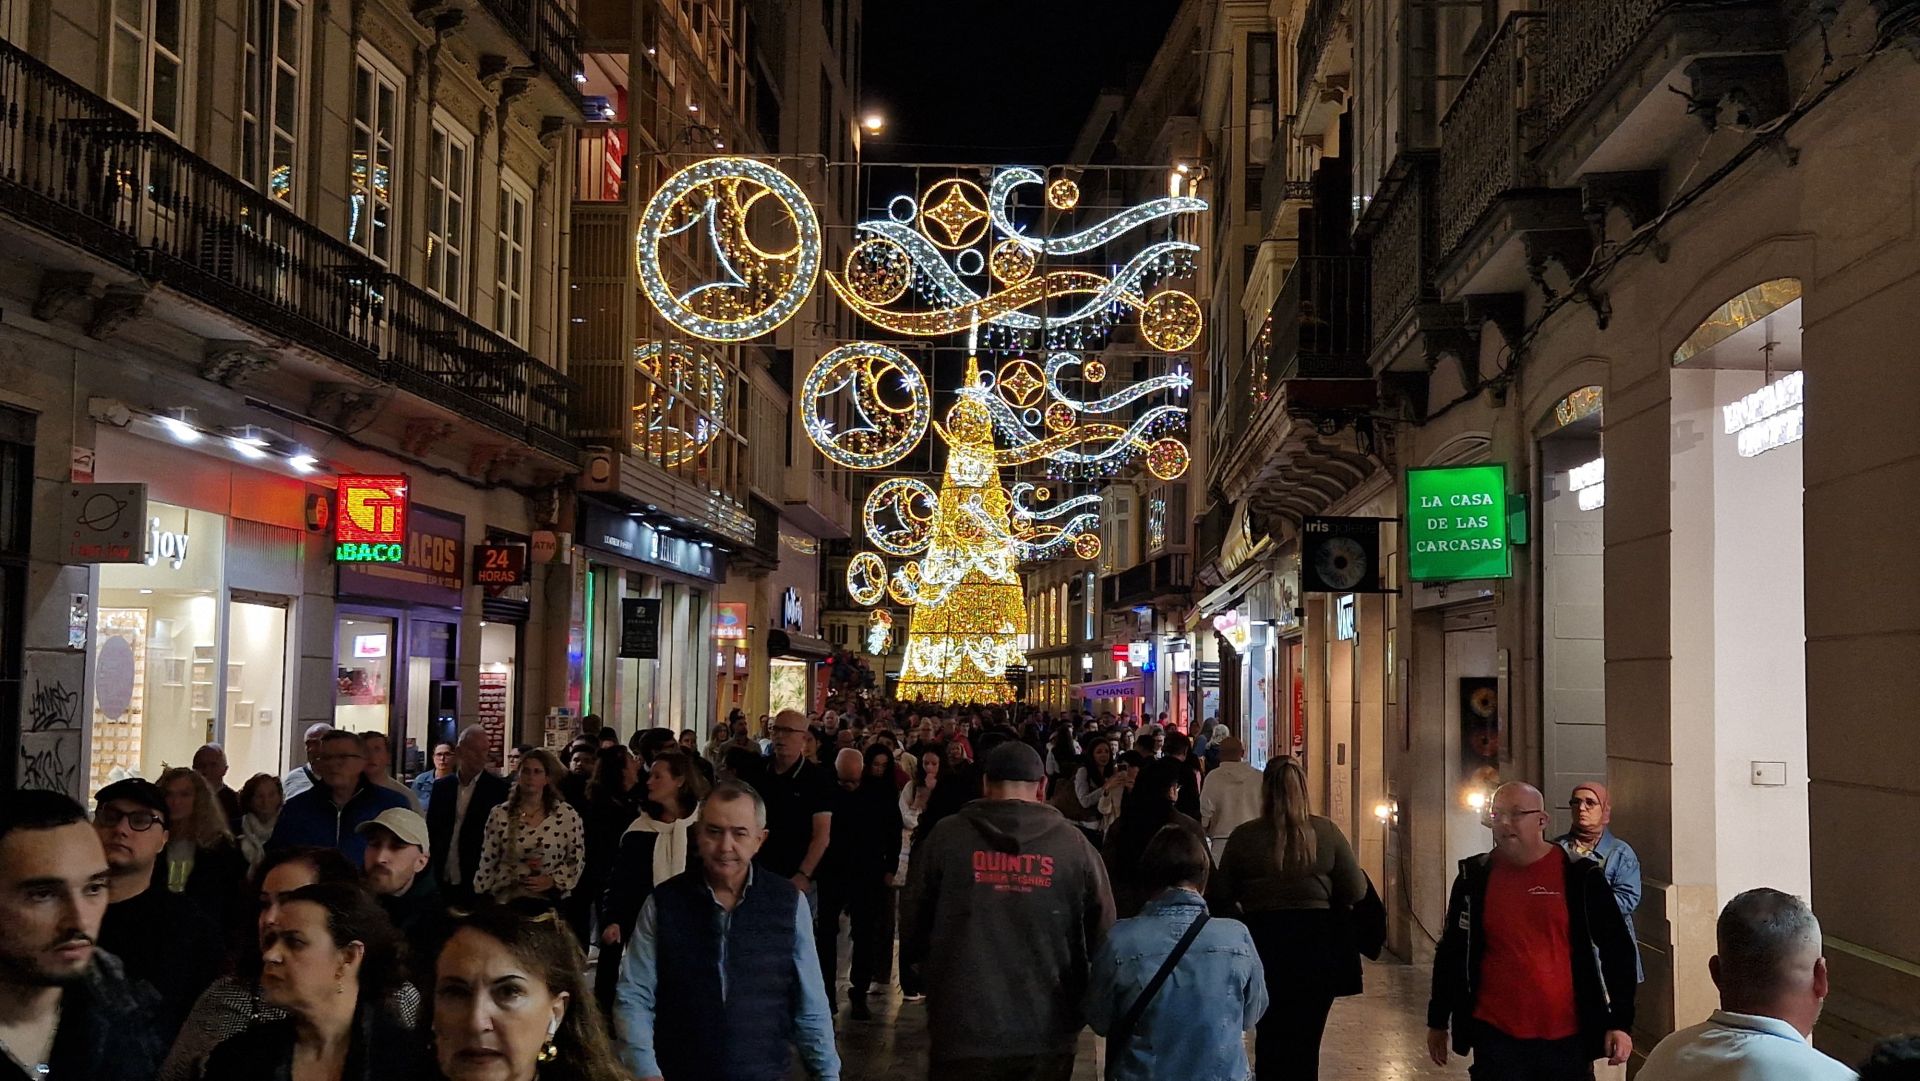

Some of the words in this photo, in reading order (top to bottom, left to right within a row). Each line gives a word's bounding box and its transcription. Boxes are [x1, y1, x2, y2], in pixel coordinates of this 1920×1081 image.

[1421, 495, 1443, 508] LA
[1450, 493, 1494, 506] CASA
[1305, 519, 1329, 533] iris
[1427, 517, 1448, 530] DE
[1456, 515, 1489, 529] LAS
[145, 517, 189, 570] joy
[534, 541, 556, 551] ATM
[1416, 537, 1502, 552] CARCASAS
[485, 549, 510, 568] 24
[479, 570, 516, 583] HORAS
[1095, 687, 1136, 697] CHANGE
[973, 850, 1054, 876] QUINT'S
